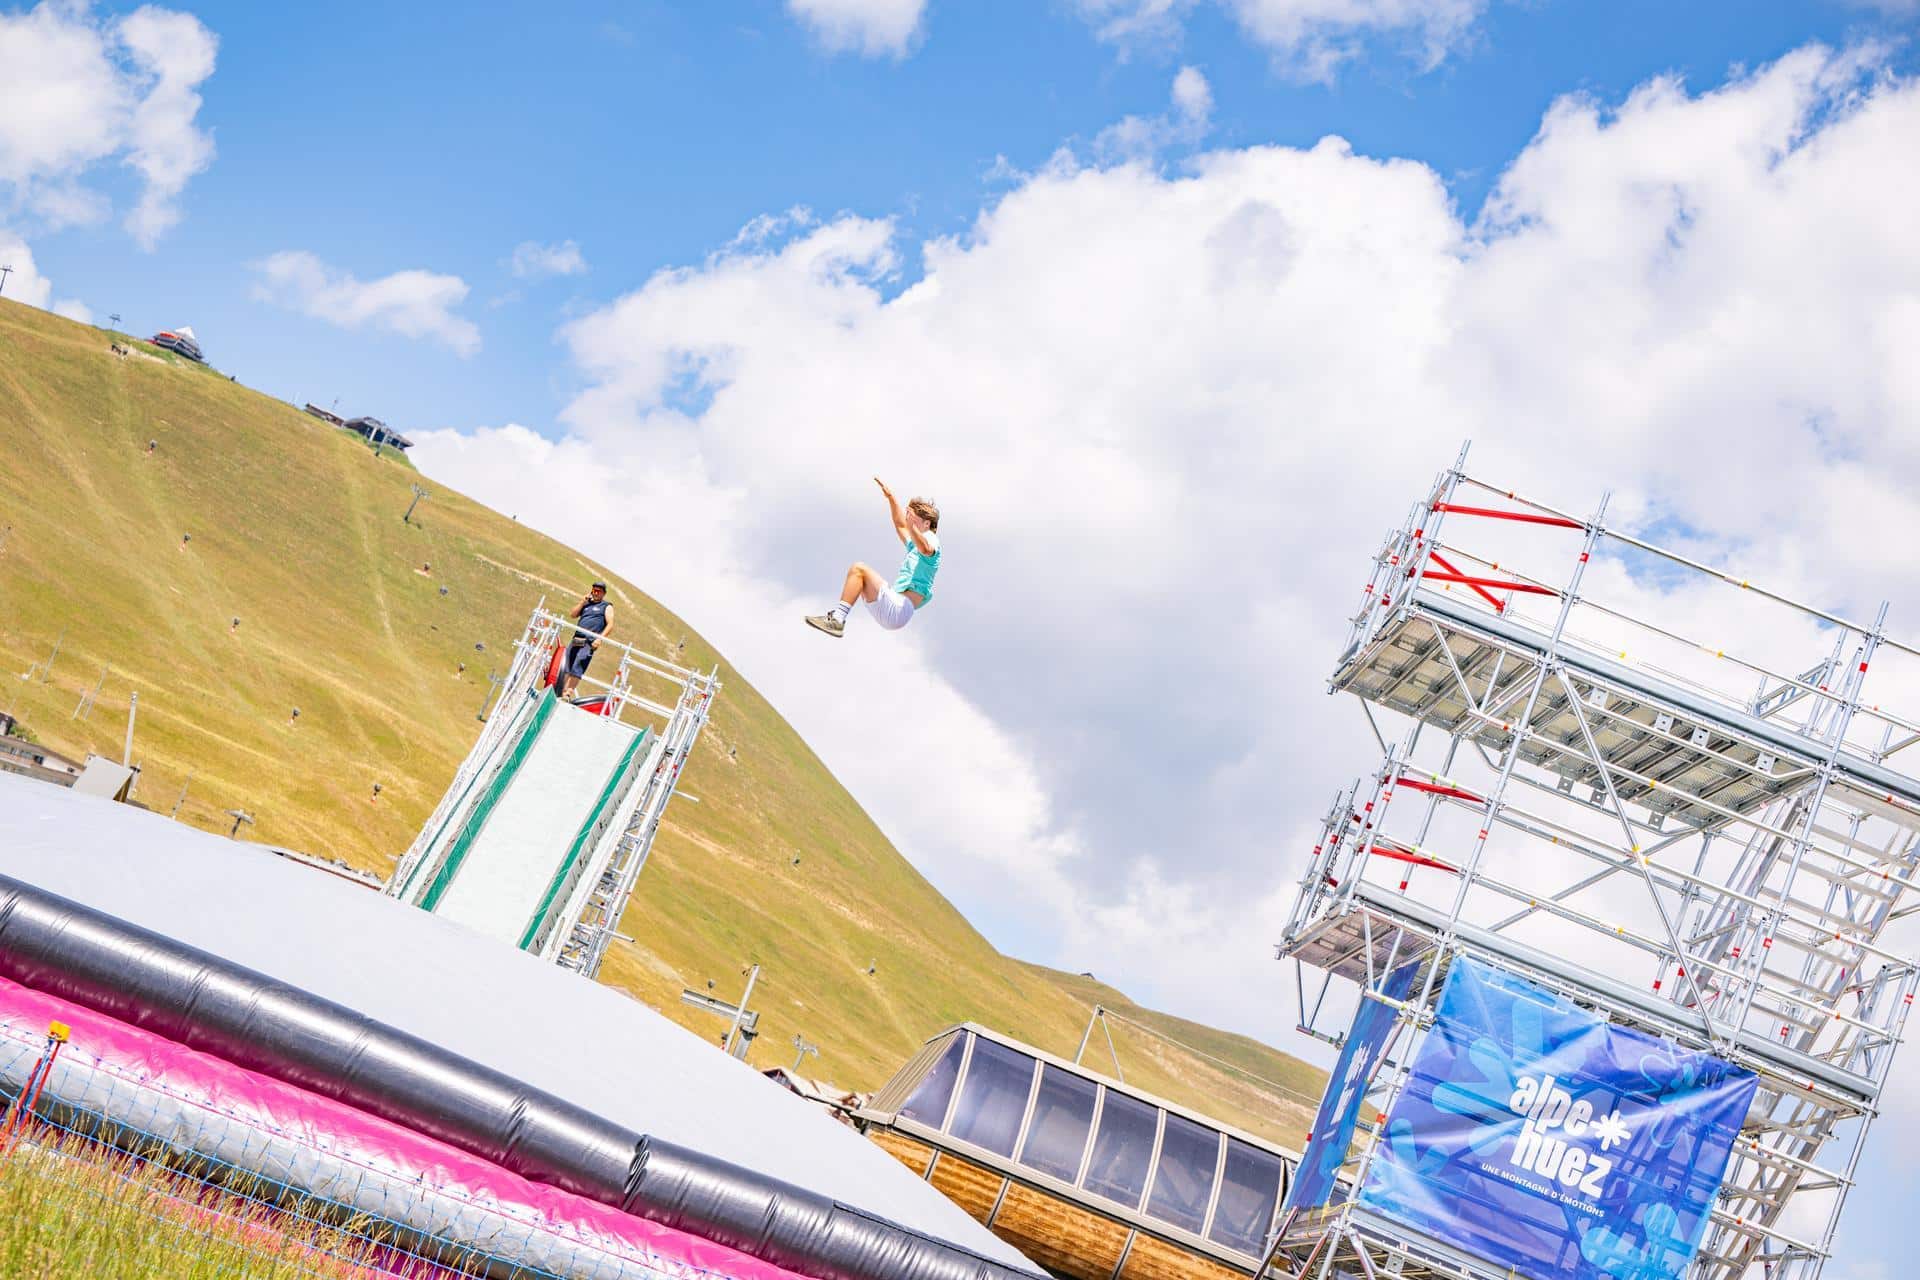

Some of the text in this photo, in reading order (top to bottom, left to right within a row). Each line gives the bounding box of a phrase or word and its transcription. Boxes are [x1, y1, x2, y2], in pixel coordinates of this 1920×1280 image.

[1509, 1074, 1593, 1136] alpe
[1510, 1118, 1612, 1198] huez
[1481, 1162, 1605, 1217] UNE MONTAGNE D'ÉMOTIONS
